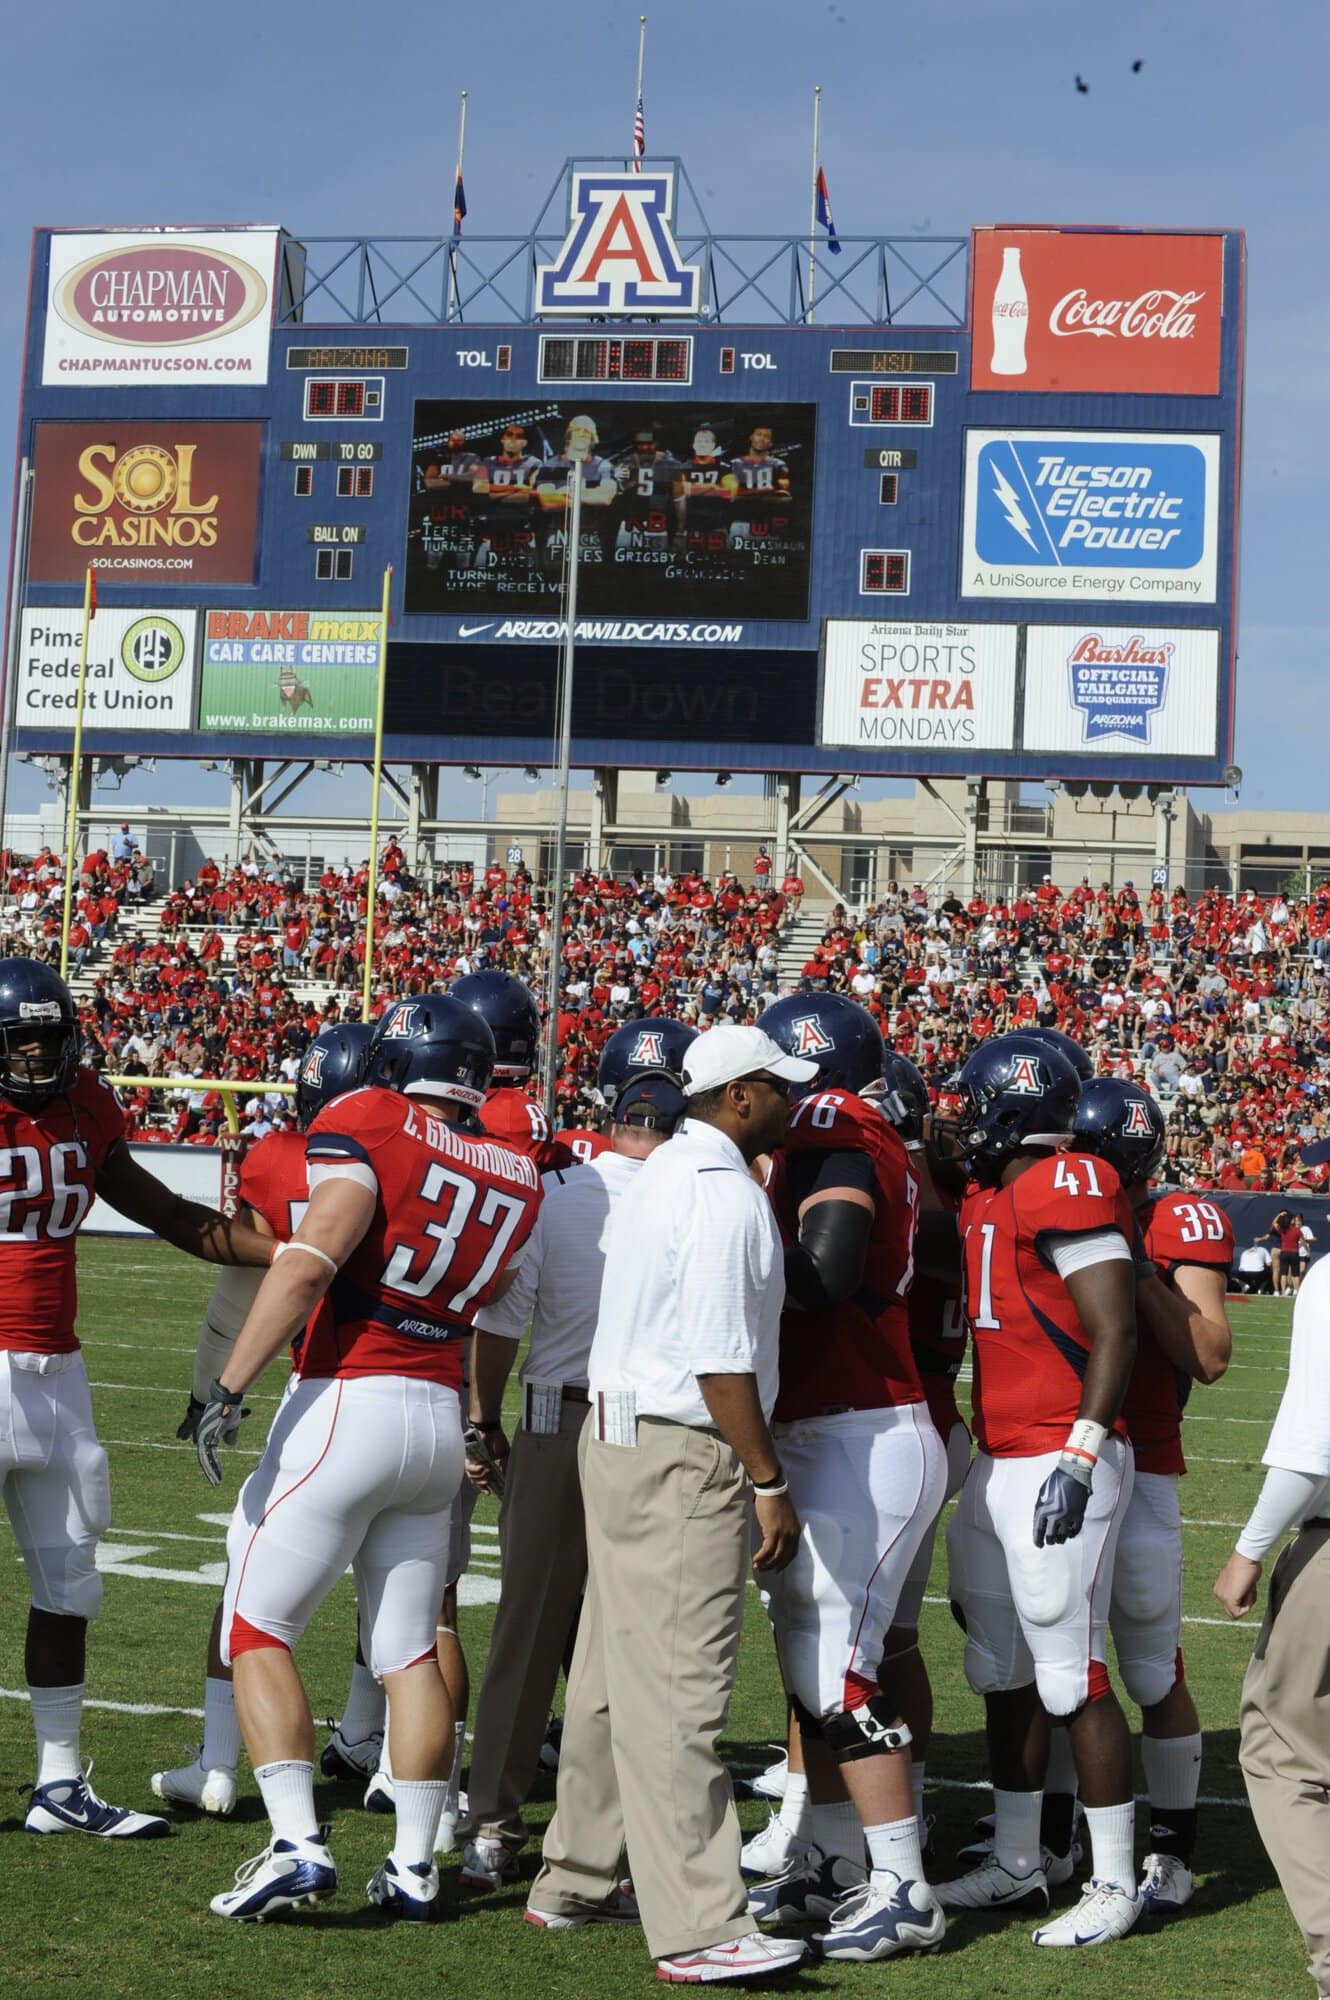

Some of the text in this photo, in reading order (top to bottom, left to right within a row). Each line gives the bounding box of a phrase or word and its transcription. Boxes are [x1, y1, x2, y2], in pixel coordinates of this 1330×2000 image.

[536, 172, 704, 314] A
[90, 270, 229, 307] CHAPMAN
[92, 309, 225, 323] AUTOMOTIVE
[1049, 288, 1206, 338] Coca-Cola
[58, 357, 252, 371] CHAPMANTUCSON.COM
[308, 349, 388, 369] ARIZONA
[456, 351, 492, 367] TOL
[741, 353, 776, 369] TOL
[872, 353, 912, 373] WSU
[292, 443, 317, 459] DWN
[340, 444, 374, 459] TO GO
[880, 450, 902, 467] QTR
[74, 444, 219, 514] SOL
[1036, 457, 1152, 488] Tucson
[1047, 492, 1183, 519] Electric
[71, 517, 218, 547] CASINOS
[314, 527, 359, 542] BALL ON
[1059, 518, 1181, 550] Power
[91, 558, 193, 570] SOLCASINOS.COM
[497, 582, 570, 593] RECEIVE
[973, 574, 1202, 594] A UniSource Energy Company
[30, 628, 85, 648] Pima
[495, 621, 743, 643] ARIZONAWILDCATS.COM
[870, 624, 969, 638] Arizona Daily Star
[209, 644, 377, 664] CAR CARE CENTERS
[860, 643, 976, 674] SPORTS
[1072, 637, 1171, 664] Bashas'
[28, 659, 114, 678] Federal
[1078, 669, 1159, 682] OFFICIAL
[859, 678, 975, 710] EXTRA
[1078, 683, 1158, 695] TAILGATE
[26, 689, 174, 710] Credit Union
[1078, 696, 1157, 705] HEADQUARTERS
[206, 713, 374, 730] www.brakemax.com
[859, 717, 975, 742] MONDAYS
[1090, 714, 1144, 725] ARIZONA
[508, 848, 521, 862] 28
[1153, 869, 1167, 883] 29
[223, 1138, 241, 1219] WILDCAT
[1053, 1160, 1103, 1197] 41
[0, 1141, 90, 1241] 26
[1173, 1203, 1223, 1242] 39
[380, 1163, 526, 1313] 37
[396, 1319, 449, 1339] ARIZONA
